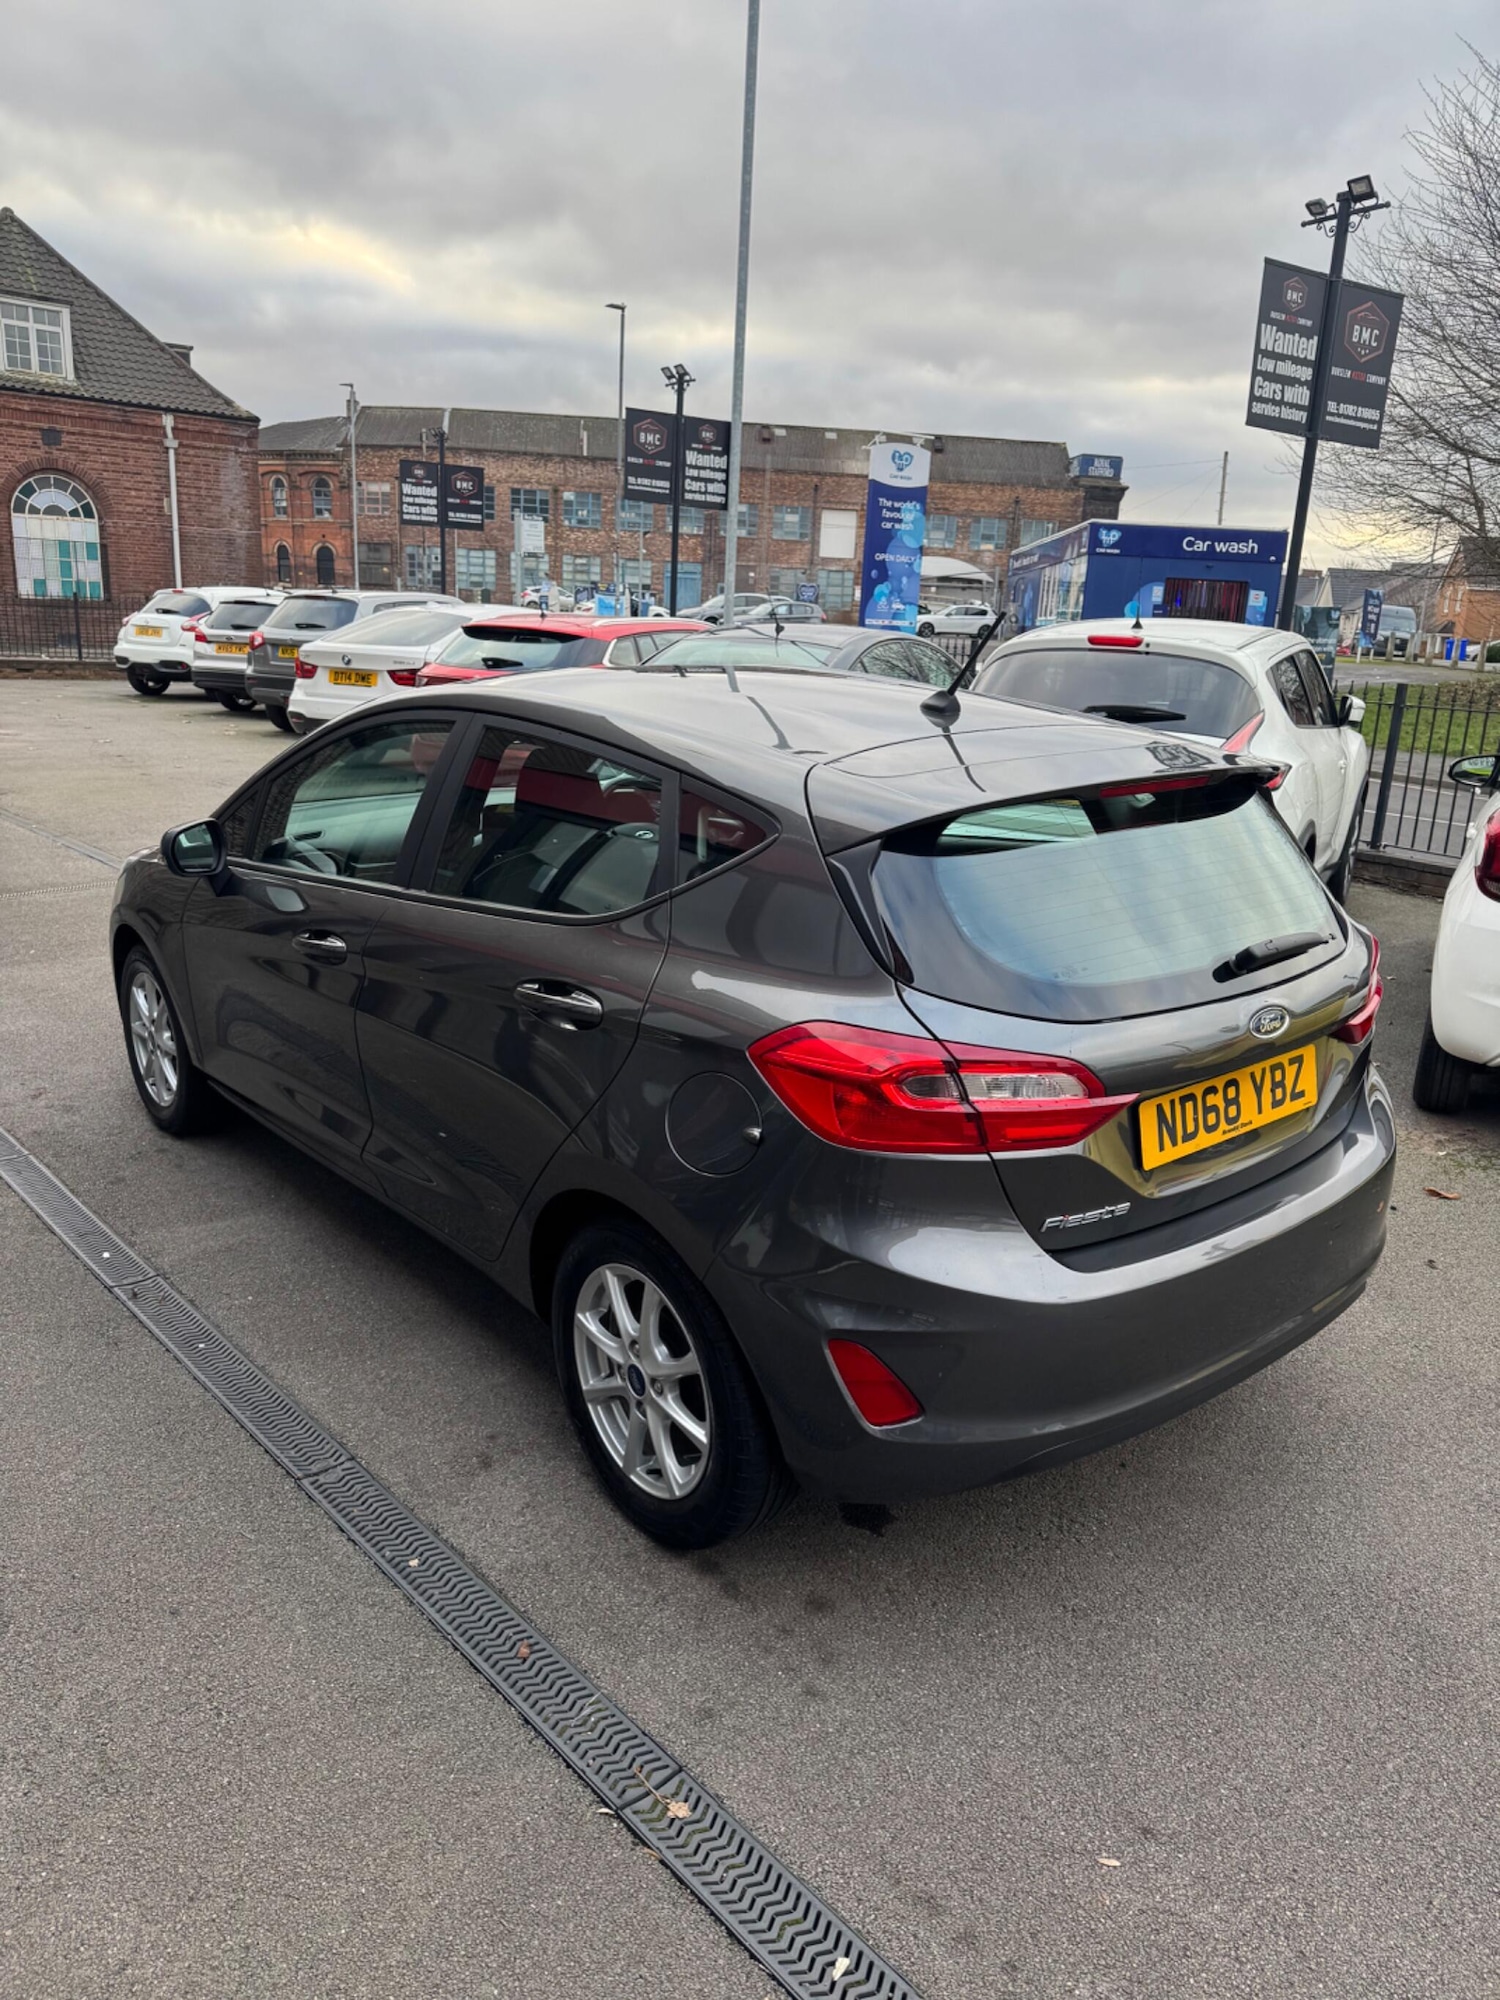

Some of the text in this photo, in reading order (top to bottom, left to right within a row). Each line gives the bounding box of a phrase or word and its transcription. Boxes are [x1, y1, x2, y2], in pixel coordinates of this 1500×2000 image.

[1260, 323, 1318, 361] Wanted
[1352, 325, 1379, 347] BMC
[1257, 354, 1313, 381] Low mileage
[1254, 376, 1310, 406] Cars with
[1251, 402, 1281, 418] service
[1280, 405, 1308, 424] history
[639, 432, 661, 445] BMC
[685, 450, 728, 469] Wanted
[401, 483, 438, 497] Wanted
[685, 479, 706, 492] Cars
[706, 481, 726, 494] with
[402, 503, 420, 514] Cars
[878, 497, 892, 507] The
[881, 521, 914, 530] car wash
[1182, 536, 1259, 554] Car wash
[874, 553, 916, 563] OPEN DAILY
[333, 670, 352, 682] DT14
[1260, 1013, 1282, 1033] Ford
[1156, 1054, 1306, 1152] ND68 YBZ
[1040, 1202, 1131, 1232] Fiesta
